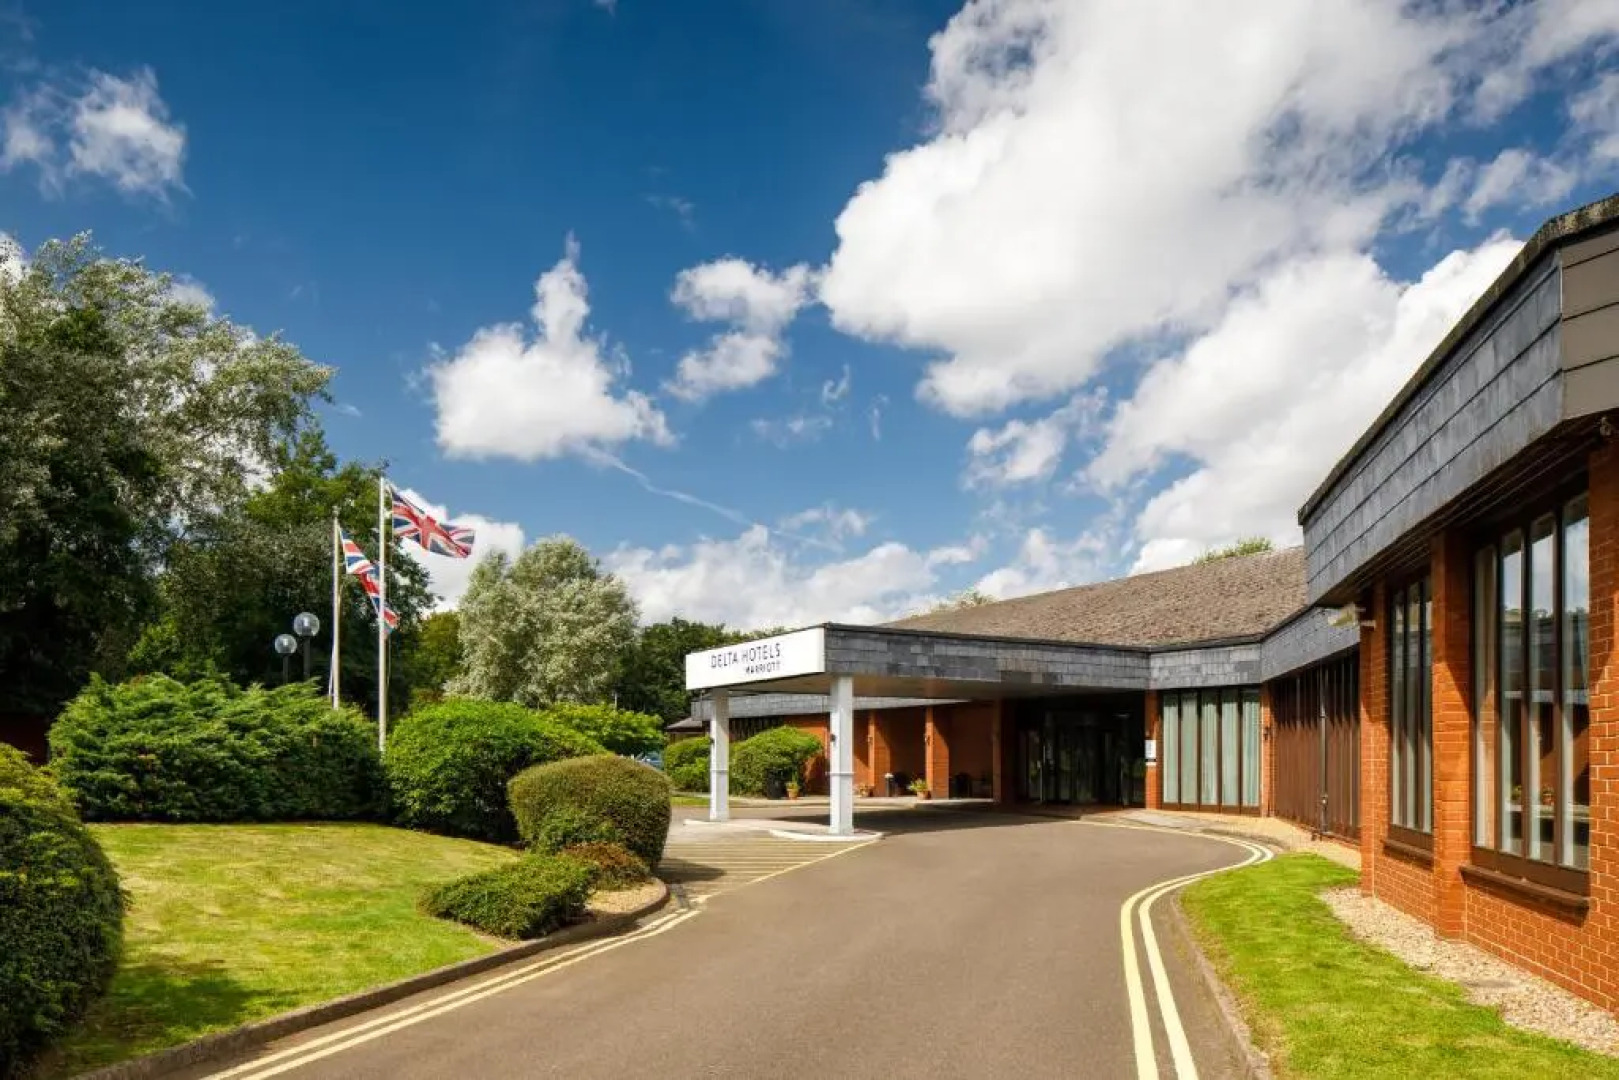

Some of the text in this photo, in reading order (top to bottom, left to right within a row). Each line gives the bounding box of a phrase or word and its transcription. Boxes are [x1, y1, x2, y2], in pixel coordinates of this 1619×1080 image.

[711, 643, 781, 668] DELTA HOTELS
[745, 662, 781, 674] MARRIOTT
